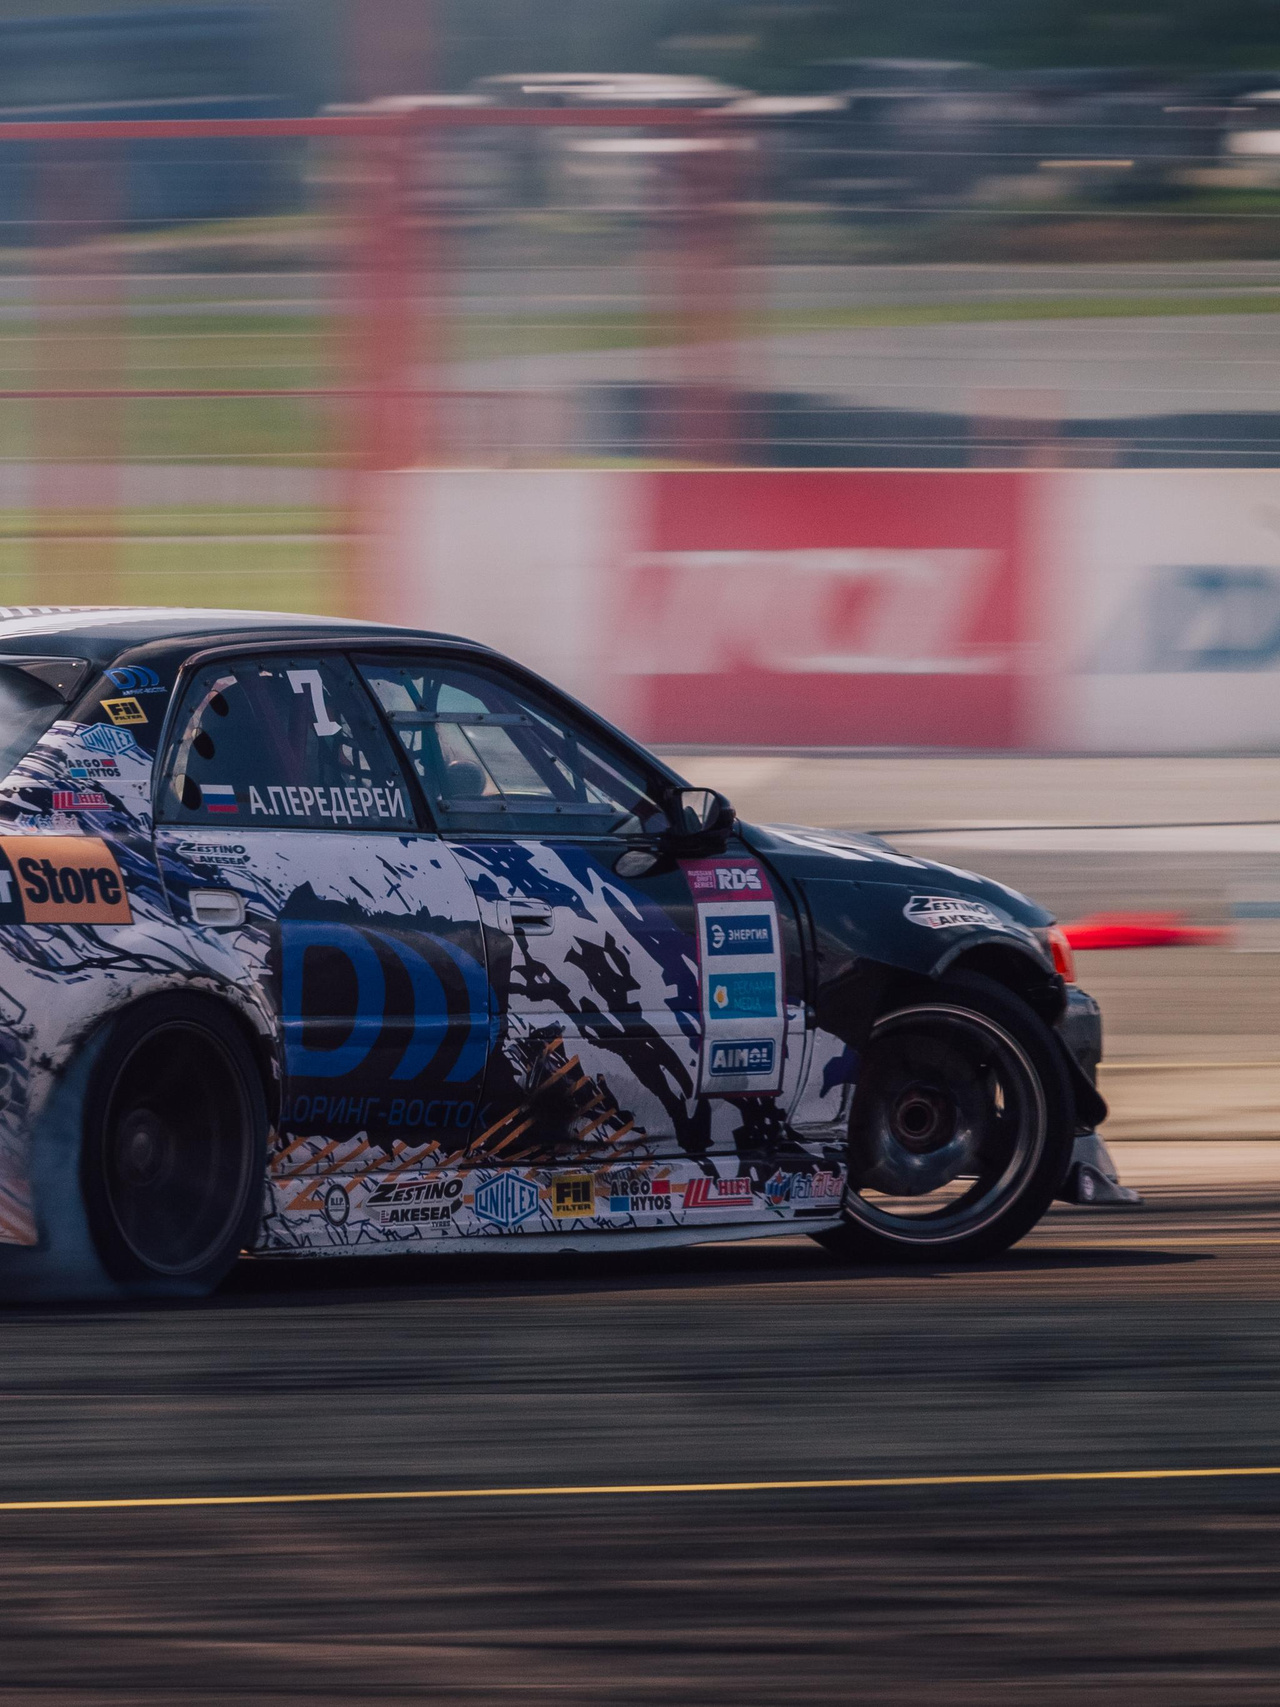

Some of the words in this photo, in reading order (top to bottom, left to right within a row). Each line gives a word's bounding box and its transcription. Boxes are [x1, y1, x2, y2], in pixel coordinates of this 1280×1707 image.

[107, 701, 140, 715] Fil
[286, 669, 342, 737] 7
[84, 727, 132, 753] UNIFLEX
[67, 759, 101, 768] ARGO
[87, 768, 121, 777] HYTOS
[249, 781, 406, 824] А.ПЕРЕДЕРЕЙ
[180, 842, 246, 854] ZESTINO
[18, 857, 121, 905] Store
[715, 868, 762, 889] RDS
[909, 897, 988, 915] ZESTINO
[728, 928, 769, 941] ЭНЕРГИЯ
[712, 1047, 771, 1068] AIMOL
[367, 1179, 463, 1203] ZESTINO
[556, 1181, 591, 1204] Fil
[610, 1180, 651, 1196] ARGO
[718, 1178, 751, 1195] HIFI
[477, 1177, 536, 1222] UNIFLEX
[556, 1204, 591, 1212] FILTER
[630, 1196, 672, 1211] HYTOS
[380, 1206, 451, 1223] LAKESEA
